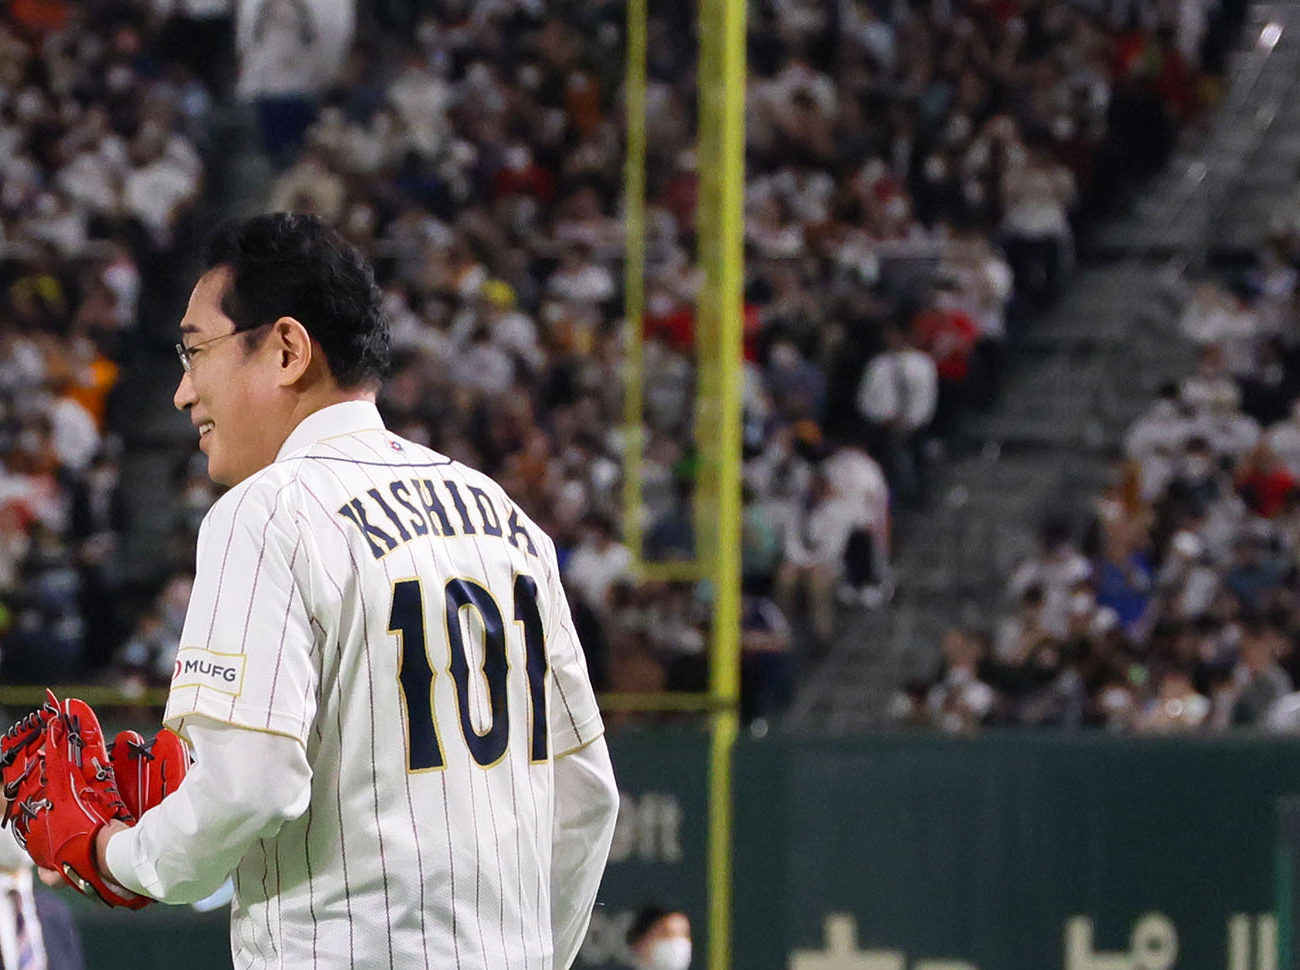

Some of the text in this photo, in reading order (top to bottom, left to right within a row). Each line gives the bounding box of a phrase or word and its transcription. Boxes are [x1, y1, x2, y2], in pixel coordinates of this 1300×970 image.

[338, 478, 539, 561] KISHIDA
[184, 659, 237, 682] MUFG
[386, 571, 550, 775] 101
